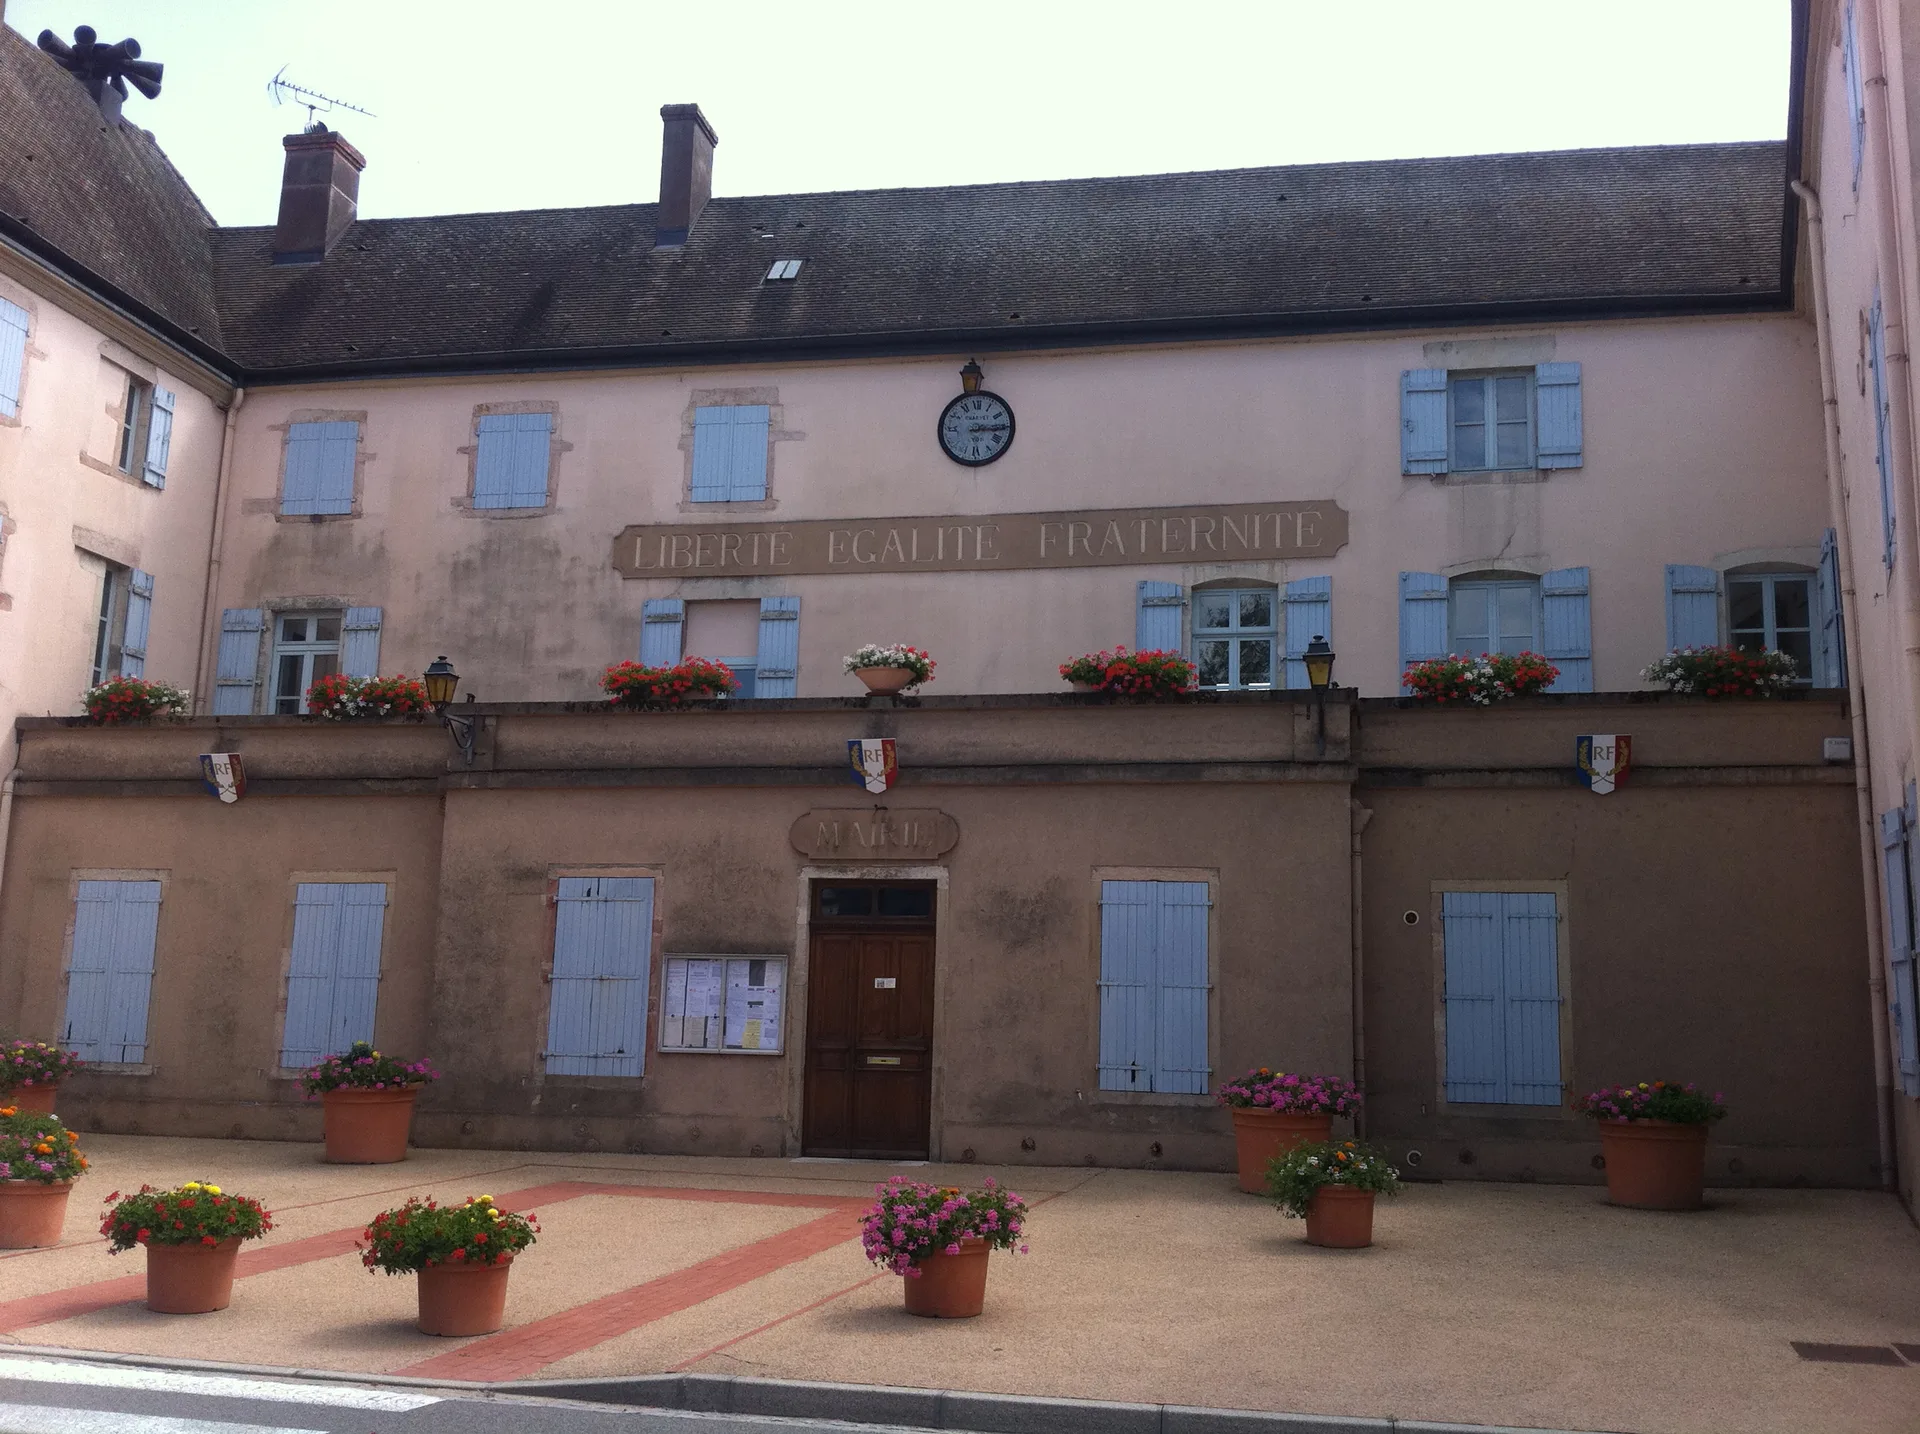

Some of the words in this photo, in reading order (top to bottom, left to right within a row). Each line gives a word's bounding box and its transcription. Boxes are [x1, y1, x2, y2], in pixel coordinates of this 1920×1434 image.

[1039, 504, 1324, 558] FRATERNITÉ
[863, 749, 883, 763] RF
[1593, 746, 1615, 760] RF
[214, 763, 231, 775] RF
